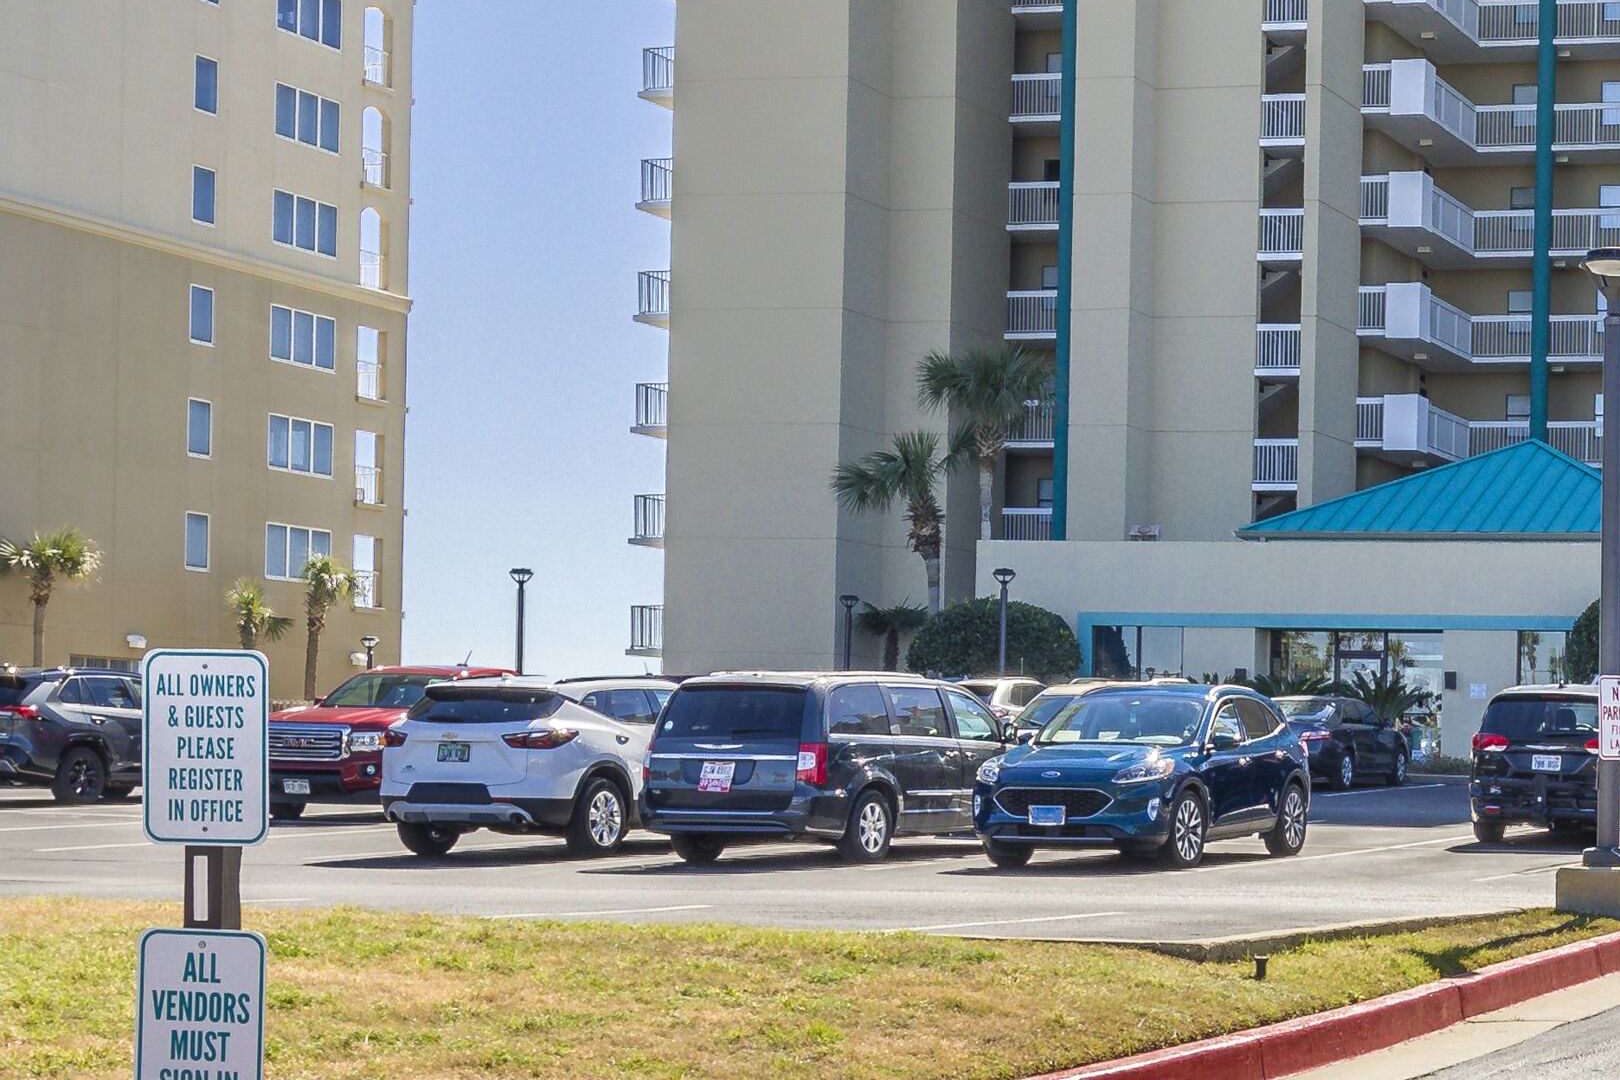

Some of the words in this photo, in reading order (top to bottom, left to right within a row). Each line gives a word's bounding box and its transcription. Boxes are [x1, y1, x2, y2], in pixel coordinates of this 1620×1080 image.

[156, 673, 184, 696] ALL
[190, 674, 256, 698] OWNERS
[168, 705, 178, 728] &
[185, 705, 244, 729] GUESTS
[177, 736, 235, 760] PLEASE
[168, 767, 243, 792] REGISTER
[168, 798, 184, 821] IN
[190, 799, 243, 823] OFFICE
[182, 952, 221, 983] ALL
[152, 989, 251, 1025] VENDORS
[170, 1029, 231, 1063] MUST
